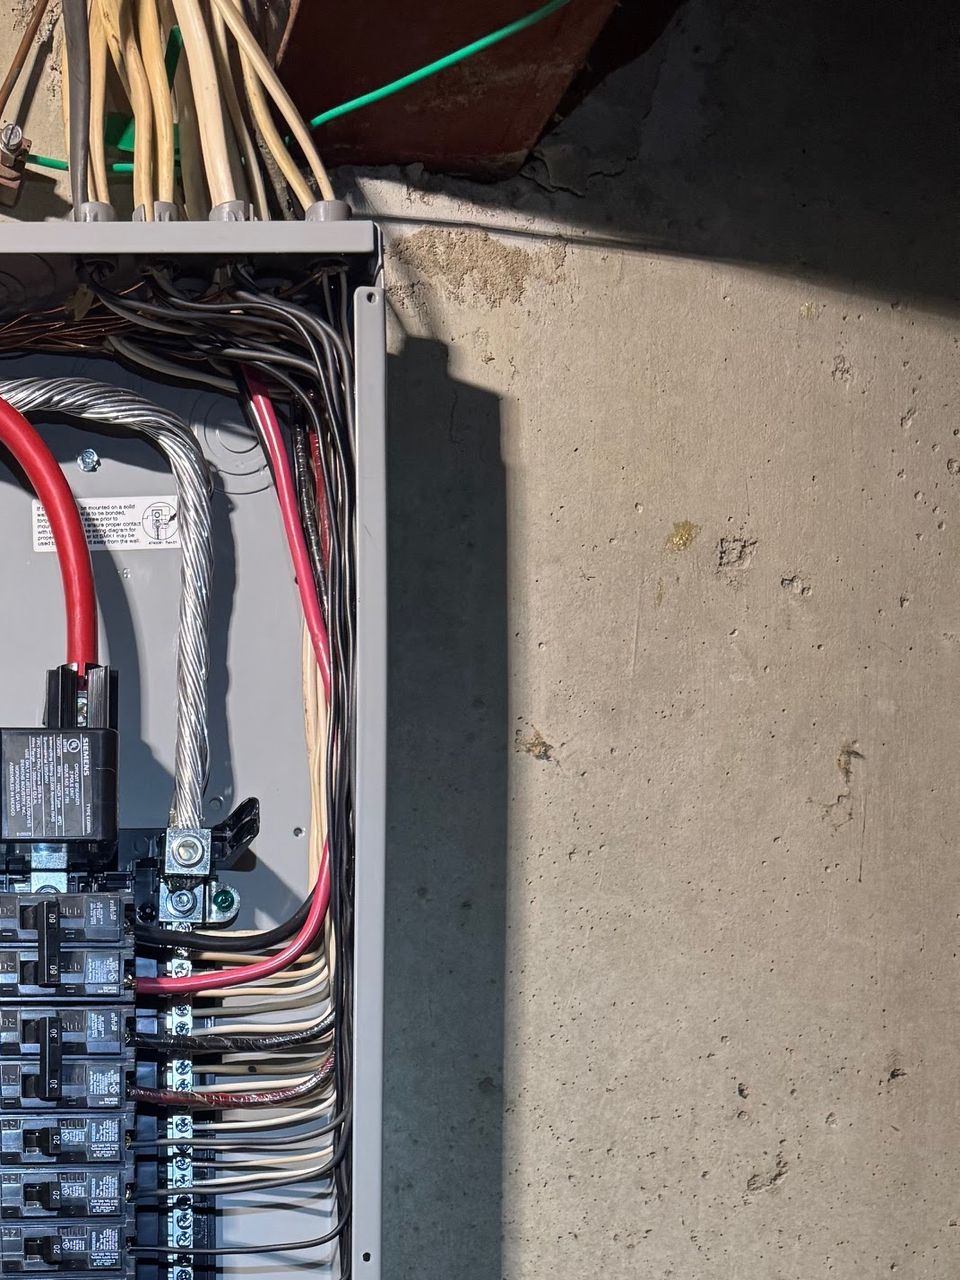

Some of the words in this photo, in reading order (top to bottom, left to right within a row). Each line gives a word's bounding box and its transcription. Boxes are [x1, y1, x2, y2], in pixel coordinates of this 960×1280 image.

[50, 1028, 57, 1038] 30
[50, 1080, 57, 1089] 30
[53, 1135, 61, 1145] 20
[53, 1190, 60, 1200] 20
[54, 1245, 61, 1254] 20
